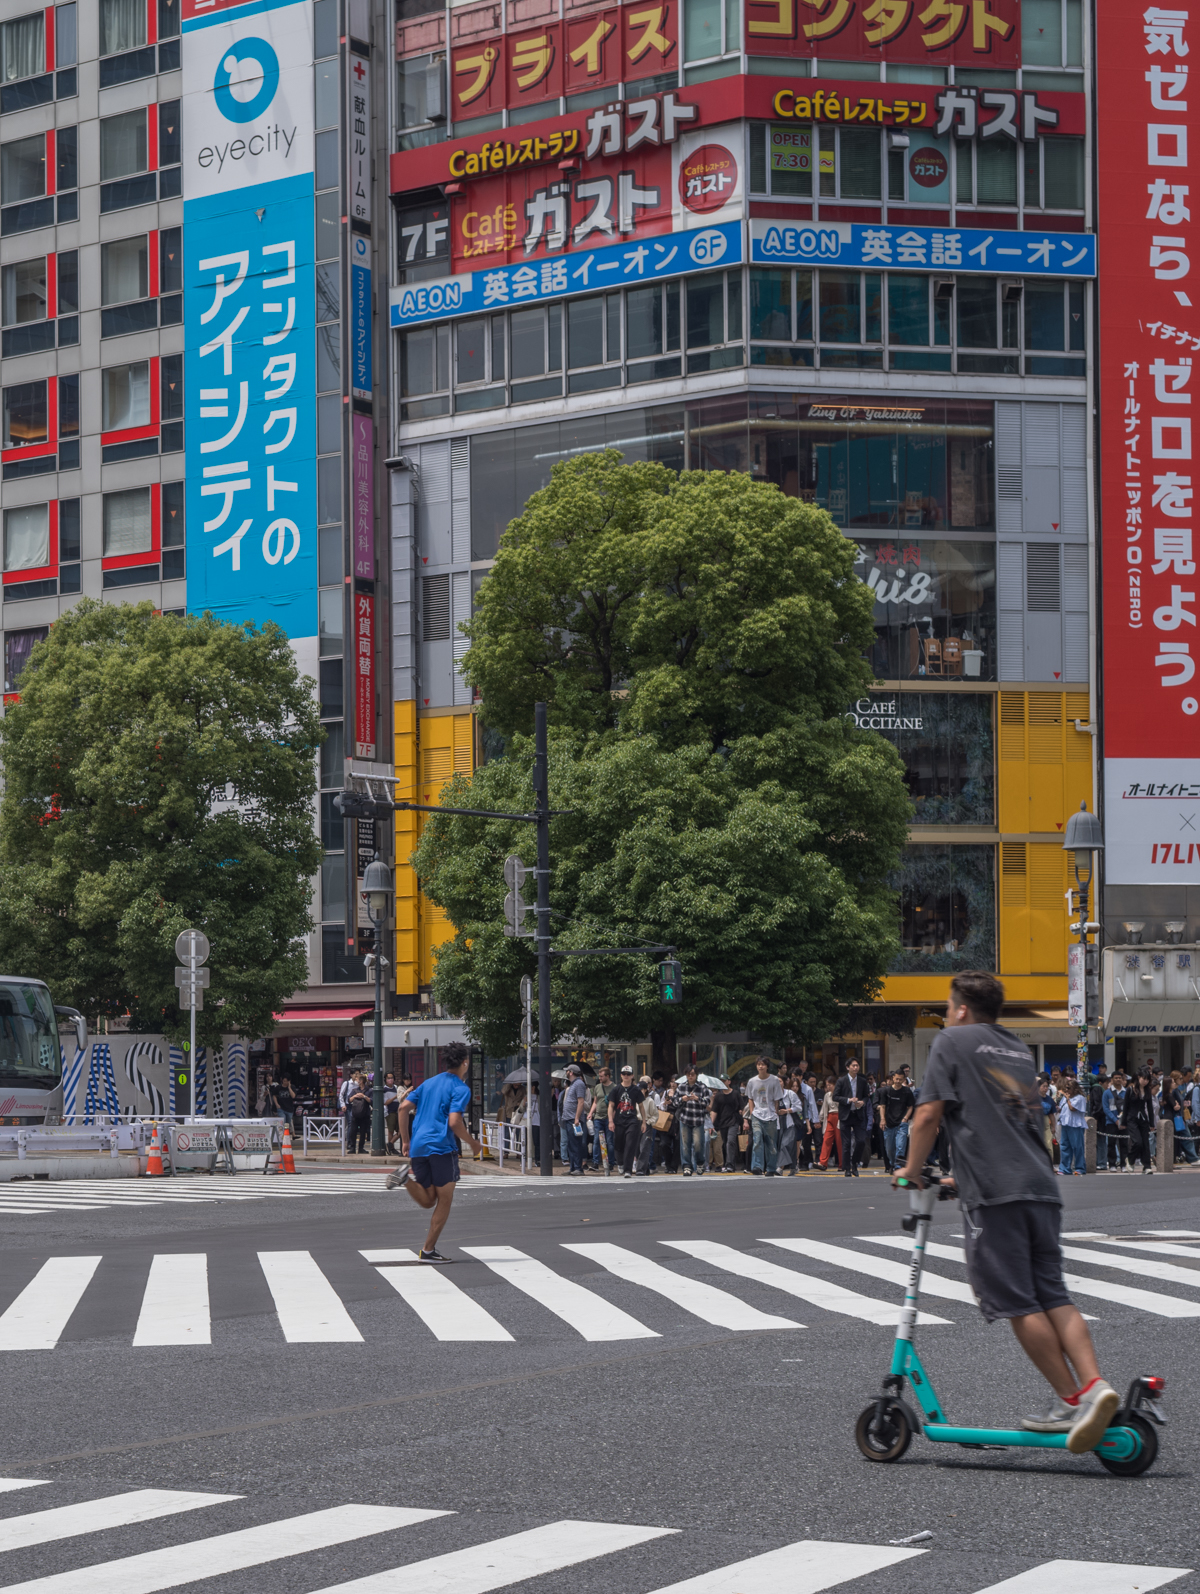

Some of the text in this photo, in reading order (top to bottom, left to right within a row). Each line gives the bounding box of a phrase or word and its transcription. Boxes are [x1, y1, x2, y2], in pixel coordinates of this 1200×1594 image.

[749, 0, 1009, 49] コンタクト
[455, 7, 672, 103] プライス
[585, 94, 696, 160] ガスト
[936, 88, 1059, 140] ガスト
[197, 123, 298, 174] eyecity
[354, 95, 366, 199] 献血ルーム
[773, 132, 810, 147] OPEN
[773, 153, 810, 168] 7:30
[914, 165, 944, 177] ガスト
[686, 173, 732, 198] ガスト
[355, 204, 367, 217] 6F
[461, 203, 518, 239] Café
[524, 173, 658, 255] ガスト
[402, 218, 449, 262] 7F
[463, 234, 517, 259] レストラン
[693, 235, 726, 259] 6F
[766, 229, 840, 253] AEON
[861, 229, 1088, 268] 英会話イーオン
[483, 243, 679, 306] 英会話イーオン
[401, 283, 461, 316] AEON
[199, 250, 254, 571] アイシティ
[262, 240, 300, 566] コンタクトの
[808, 406, 838, 421] King
[357, 444, 370, 553] 品川美容外科
[356, 560, 371, 574] 4F
[875, 544, 922, 567] 焼肉
[359, 597, 371, 676] 外貨両替
[856, 697, 897, 715] CAFÉ
[359, 743, 372, 757] 7F
[1128, 783, 1200, 796] オールナイトニ
[1126, 954, 1191, 969] 渋谷駅
[1114, 1025, 1157, 1033] SHIBUYA
